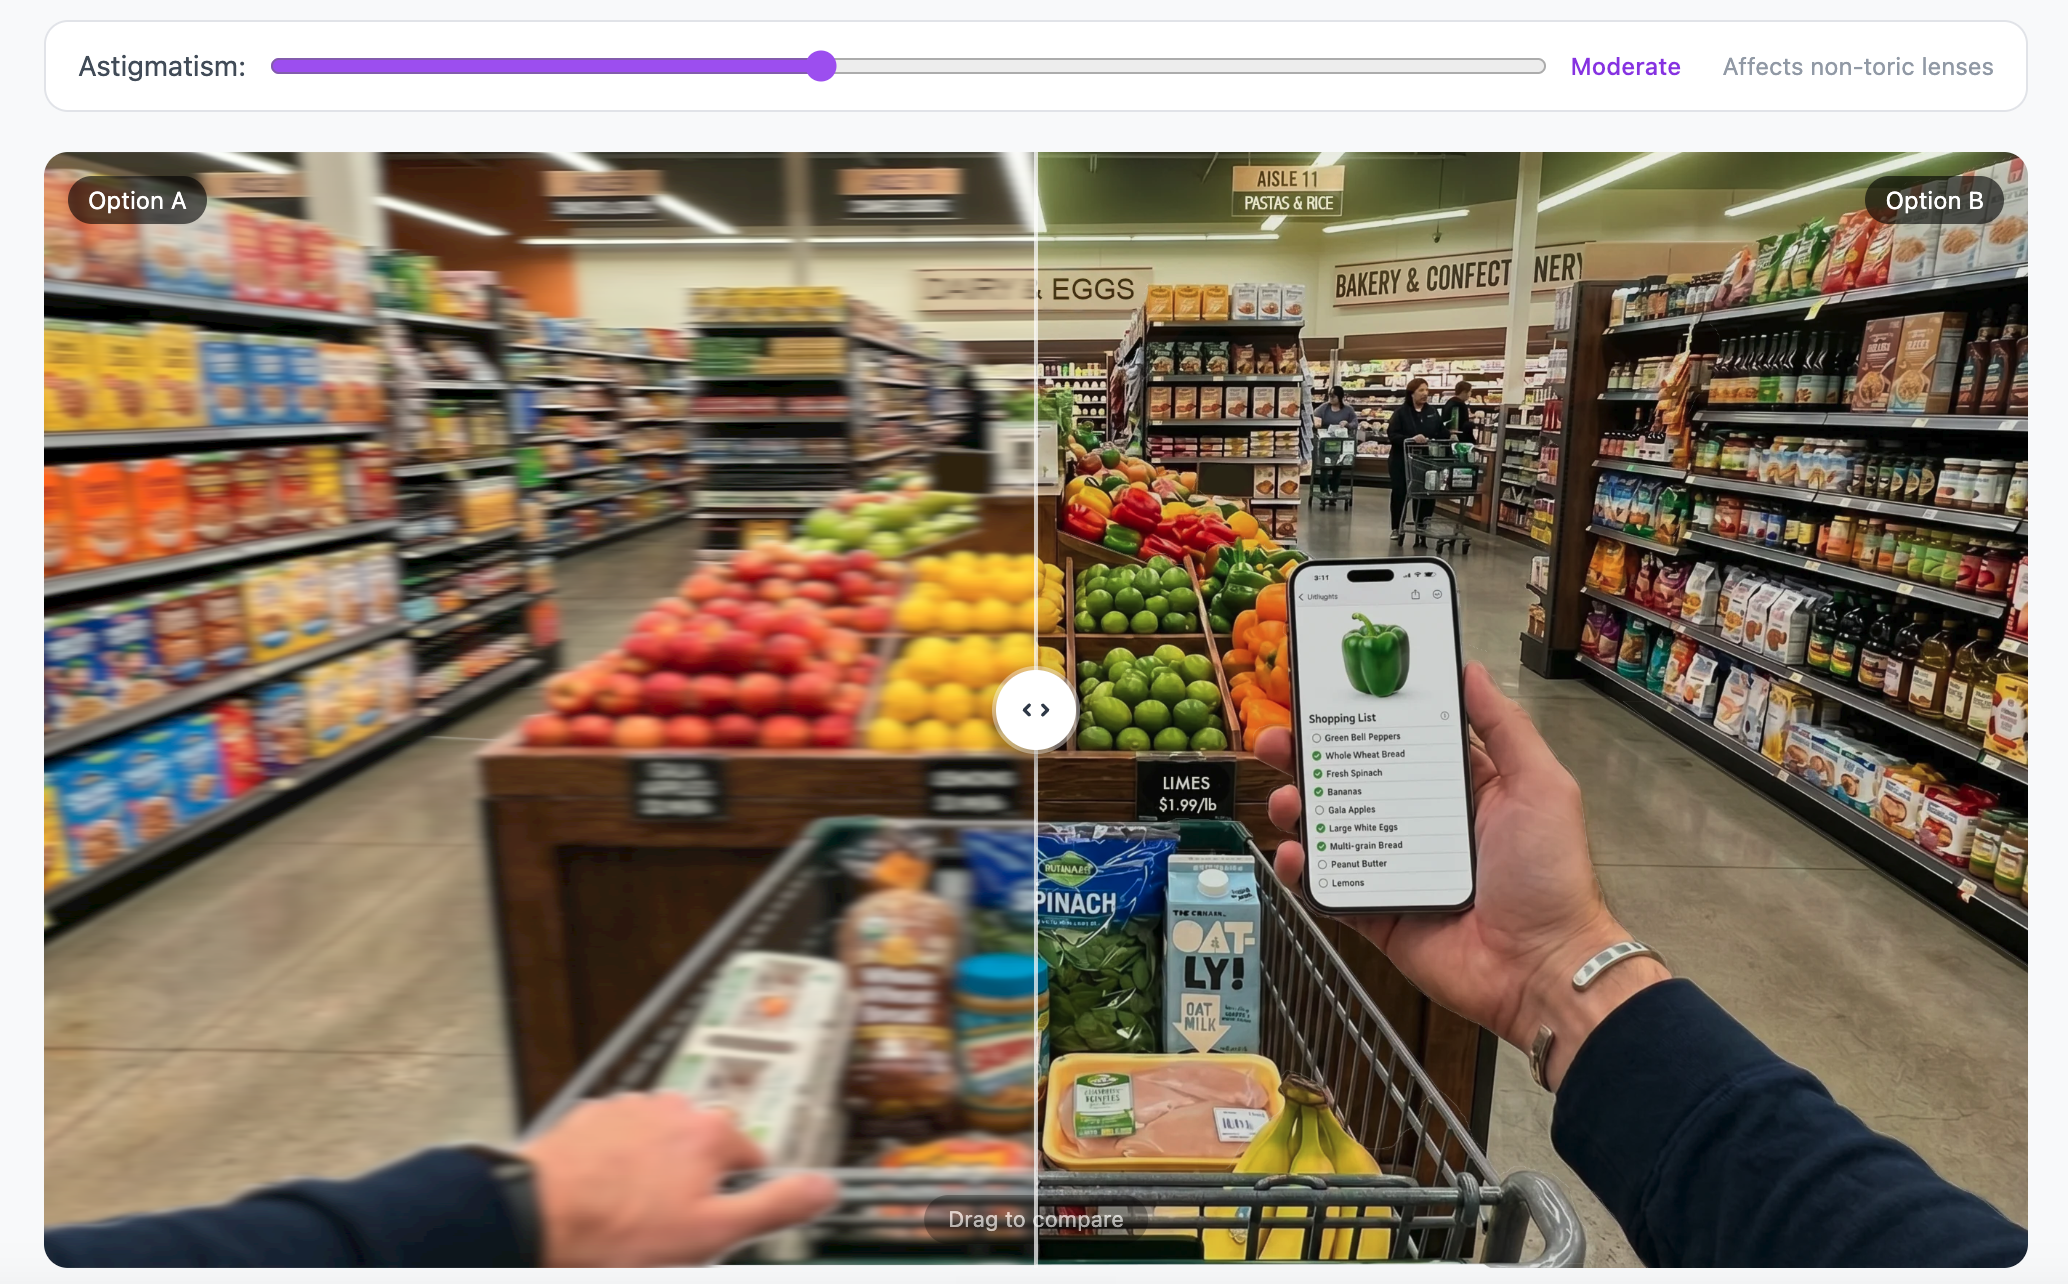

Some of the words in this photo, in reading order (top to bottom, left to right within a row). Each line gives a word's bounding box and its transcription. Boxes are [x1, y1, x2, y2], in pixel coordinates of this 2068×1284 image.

[1257, 170, 1298, 187] AISLE
[1302, 170, 1317, 188] 11
[1244, 195, 1290, 210] PASTAS
[1293, 195, 1303, 210] &
[1306, 195, 1334, 210] RICE
[1336, 268, 1401, 298] BAKERY
[1406, 267, 1420, 293] &
[1426, 252, 1583, 291] CONFECTNERY
[1053, 277, 1134, 300] EGGS
[1309, 714, 1356, 726] Shopping
[1358, 713, 1376, 723] List
[1325, 734, 1349, 742] Green
[1351, 733, 1366, 741] Bell
[1368, 733, 1401, 742] Peppers
[1325, 752, 1352, 760] Whole
[1353, 751, 1380, 759] Wheat
[1382, 750, 1405, 758] Bread
[1351, 769, 1383, 778] Spinach
[1163, 776, 1210, 790] LIMES
[1327, 788, 1362, 796] Bananas
[1159, 797, 1217, 814] $1.99/lb
[1328, 806, 1346, 814] Gala
[1348, 805, 1376, 815] Apples
[1329, 824, 1352, 833] Large
[1354, 824, 1377, 832] White
[1379, 823, 1398, 833] Eggs
[1330, 842, 1376, 851] Multi-grain
[1379, 841, 1403, 849] Bread
[1331, 860, 1359, 868] Peanut
[1362, 860, 1387, 868] Butter
[1332, 879, 1365, 887] Lemons
[1017, 890, 1117, 914] PINACH
[1185, 956, 1244, 990] LY!
[1186, 1002, 1213, 1016] OAT
[1184, 1017, 1217, 1032] MILK
